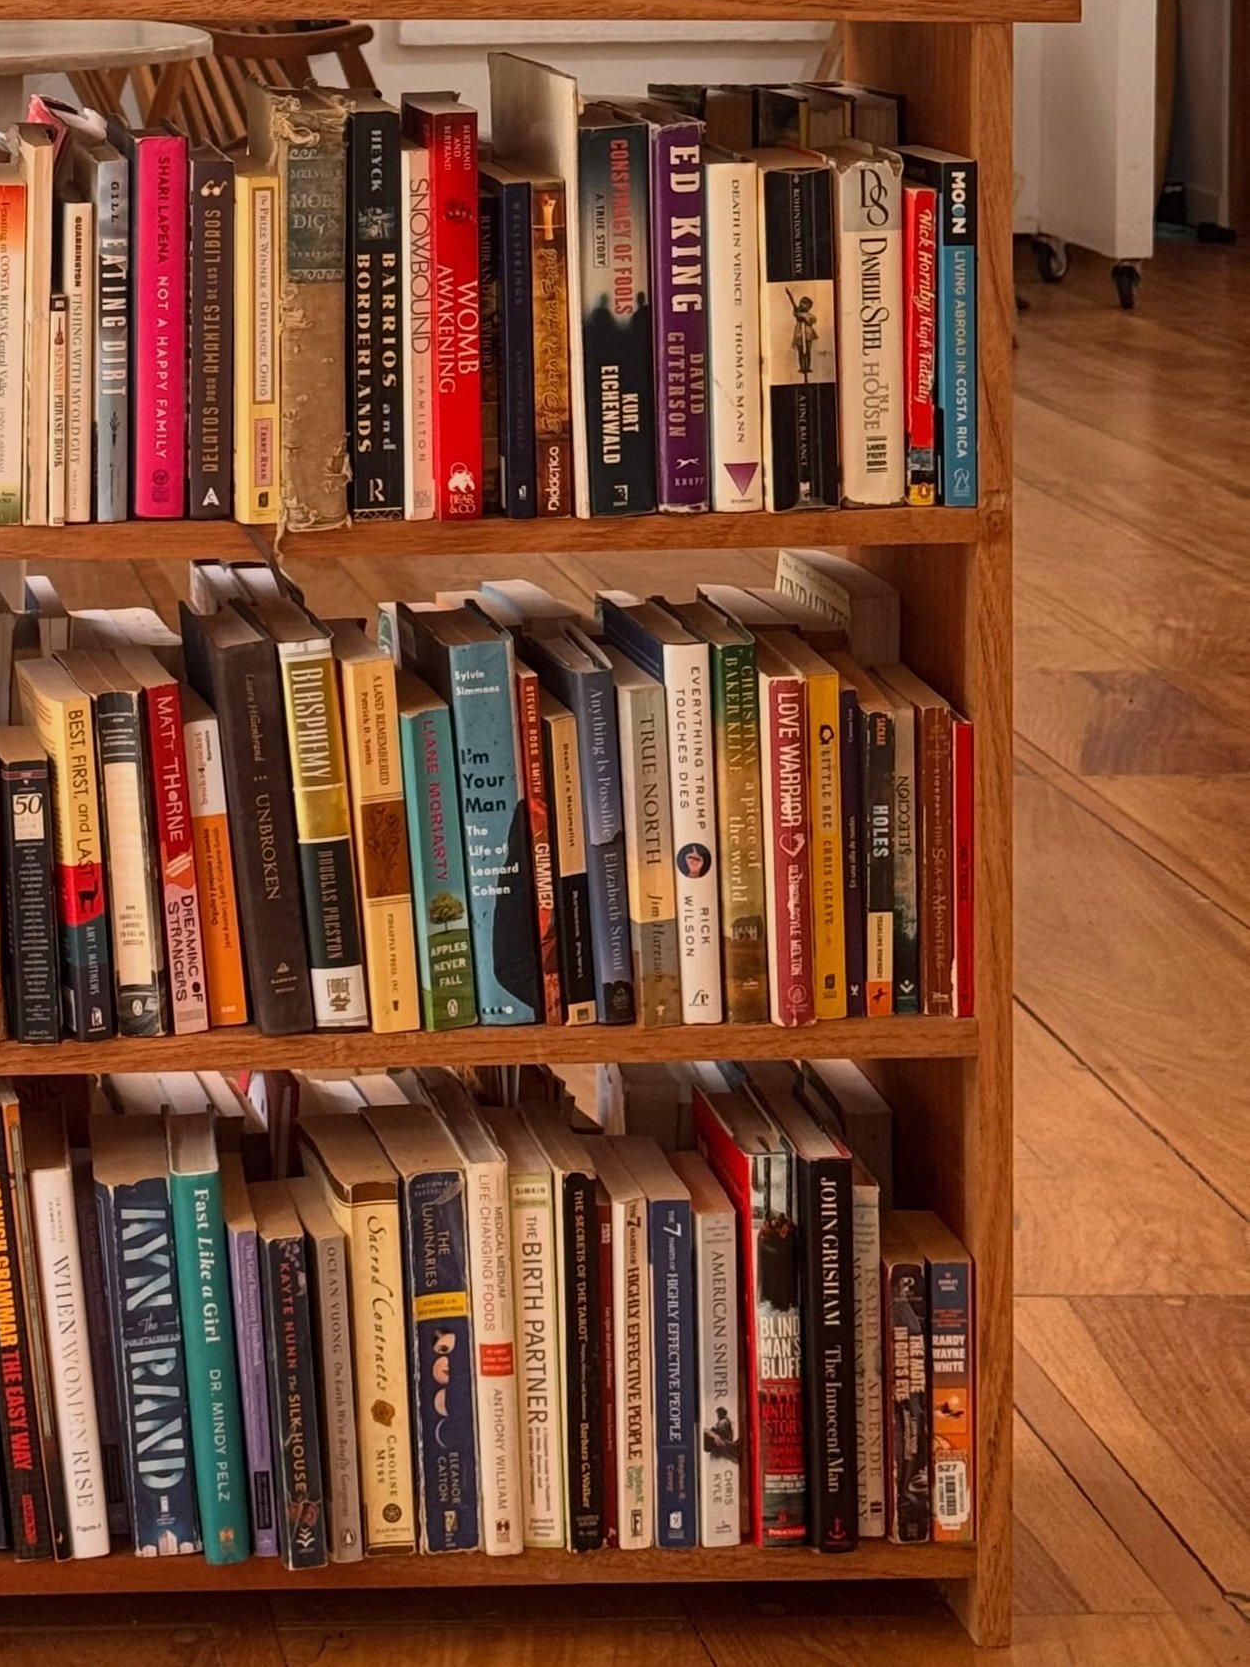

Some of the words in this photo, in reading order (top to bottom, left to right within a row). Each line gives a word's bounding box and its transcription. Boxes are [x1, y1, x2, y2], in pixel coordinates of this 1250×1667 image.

[157, 156, 170, 204] SHARI
[670, 145, 700, 194] ED
[951, 171, 966, 234] MOON
[156, 207, 170, 262] LAPENA
[101, 238, 127, 329] EATING
[409, 179, 431, 354] SNOWBOUND
[670, 215, 702, 313] KING
[954, 250, 965, 296] LIVING
[156, 276, 169, 310] NOT
[156, 317, 167, 327] A
[381, 253, 397, 386] BARRIOS
[437, 264, 456, 394] AWAKENING
[456, 281, 480, 374] WOMB
[954, 300, 966, 356] ABROAD
[101, 340, 127, 397] DIRT
[156, 336, 168, 391] HAPPY
[357, 253, 372, 453] BORDERLANDS
[955, 360, 965, 370] IN
[667, 332, 685, 438] GUTERSON
[689, 353, 704, 415] DAVID
[956, 372, 967, 417] COSTA
[155, 399, 168, 458] FAMILY
[382, 403, 396, 450] and
[600, 365, 620, 465] EICHENWALD
[621, 392, 639, 433] KURT
[956, 421, 967, 458] RICA
[290, 667, 331, 778] BLASPHEMY
[675, 689, 688, 766] TOUCHES
[691, 666, 703, 767] EVERYTHING
[461, 749, 489, 765] I'm
[639, 716, 655, 772] TRUE
[463, 773, 504, 790] Your
[465, 798, 506, 813] Man
[679, 772, 689, 809] DIES
[694, 775, 706, 829] TRUMP
[255, 794, 280, 899] UNBROKEN
[466, 826, 488, 836] The
[642, 781, 661, 867] NORTH
[872, 804, 889, 858] HOLES
[468, 845, 491, 857] Life
[494, 845, 508, 856] of
[471, 863, 519, 875] Leonard
[473, 885, 511, 896] Cohen
[684, 896, 694, 957] WILSON
[700, 907, 710, 944] RICK
[193, 1188, 209, 1230] Fast
[820, 1177, 837, 1229] JOHN
[120, 1208, 172, 1311] AYN
[196, 1236, 215, 1280] Like
[522, 1242, 543, 1311] BIRTH
[822, 1234, 840, 1327] GRISHAM
[202, 1285, 214, 1297] a
[711, 1251, 726, 1335] AMERICAN
[202, 1303, 221, 1344] Girl
[932, 1335, 965, 1346] RANDY
[2, 1350, 20, 1380] THE
[523, 1318, 548, 1424] PARTNER
[713, 1340, 728, 1400] SNIPER
[824, 1345, 841, 1380] The
[933, 1348, 965, 1359] WAYNE
[933, 1360, 964, 1372] WHITE
[5, 1383, 26, 1429] EASY
[209, 1368, 221, 1398] DR.
[130, 1347, 185, 1489] RAND
[212, 1403, 227, 1455] MINDY
[825, 1384, 843, 1452] Innocent
[12, 1430, 31, 1471] WAY
[828, 1455, 844, 1493] Man
[217, 1461, 230, 1503] PELZ
